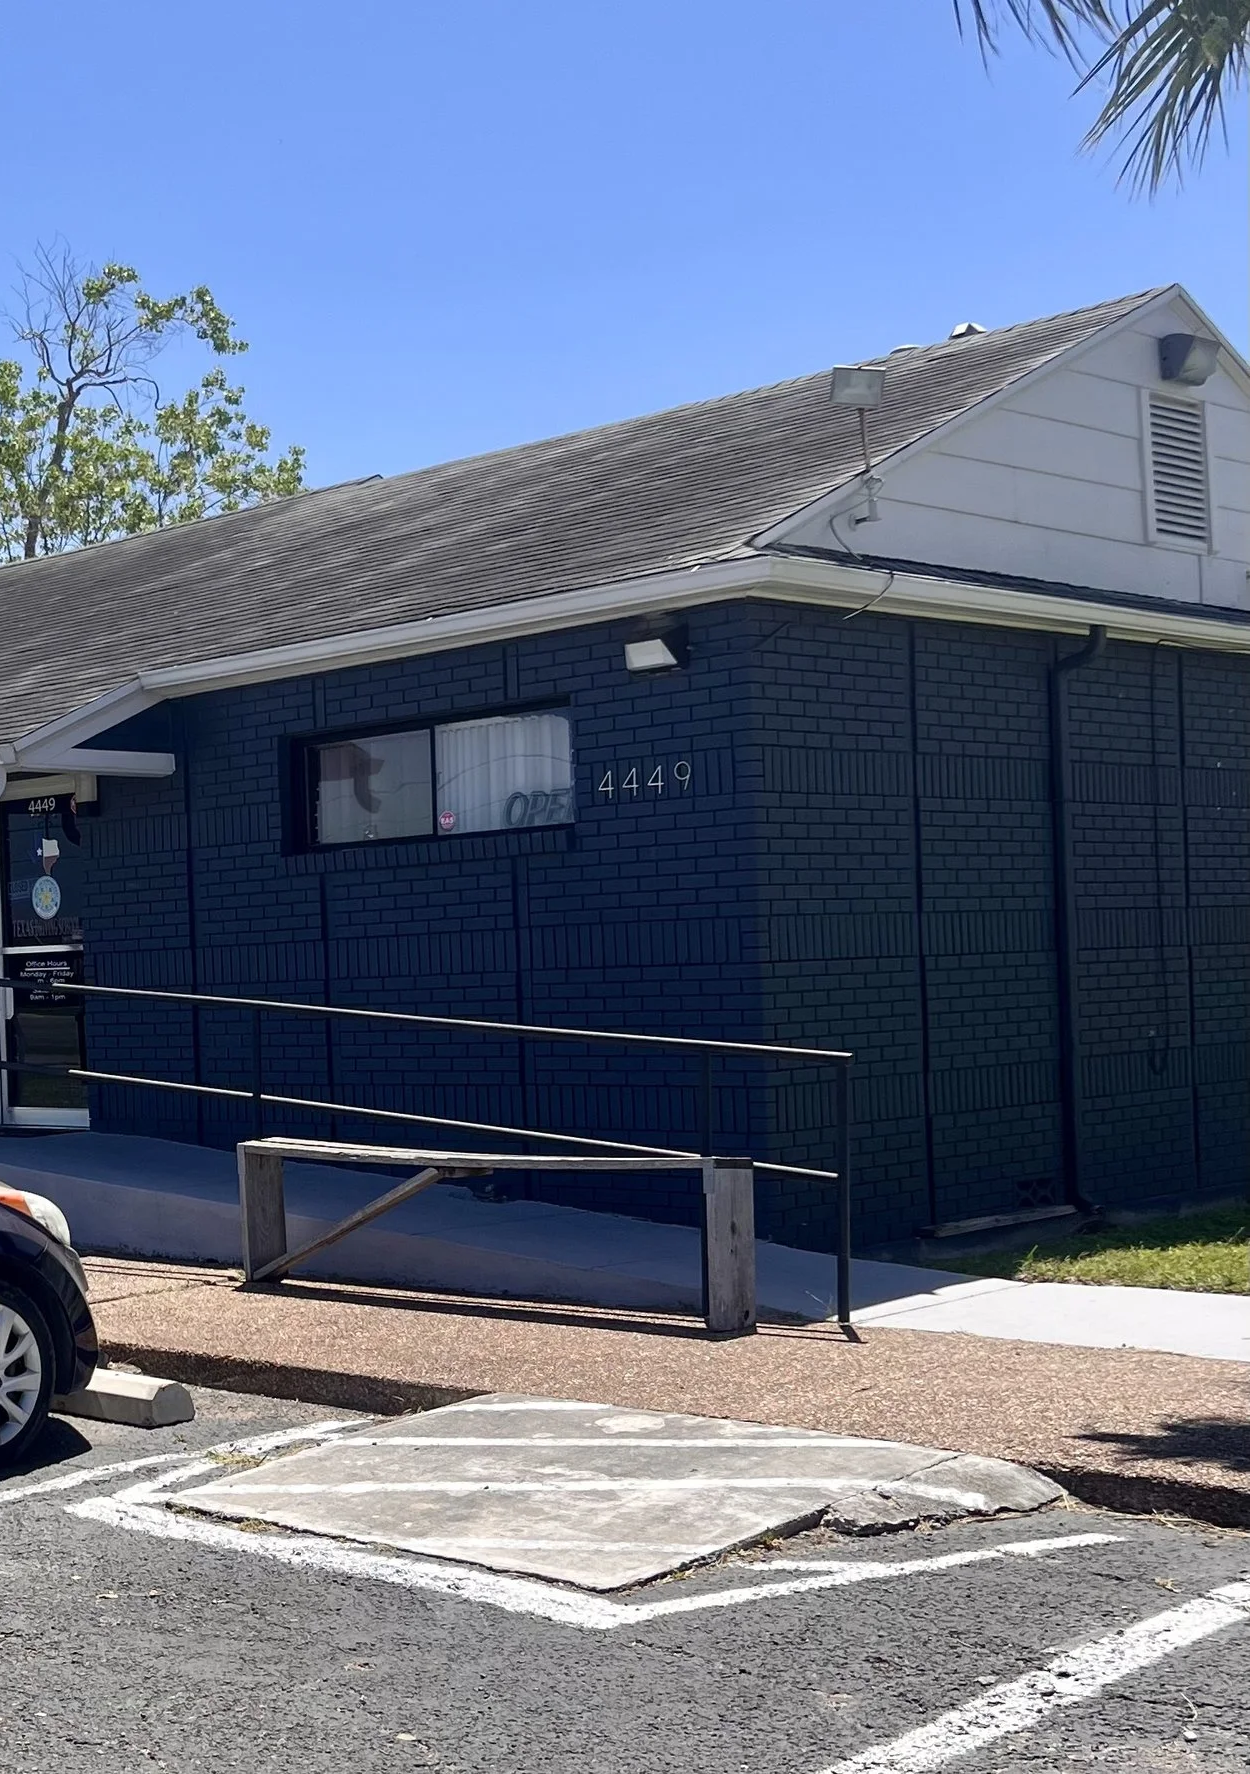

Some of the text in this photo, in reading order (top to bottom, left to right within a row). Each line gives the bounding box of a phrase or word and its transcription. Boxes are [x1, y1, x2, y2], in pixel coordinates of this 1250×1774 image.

[598, 761, 691, 799] 4449
[28, 797, 56, 813] 4449
[52, 970, 75, 978] Friday
